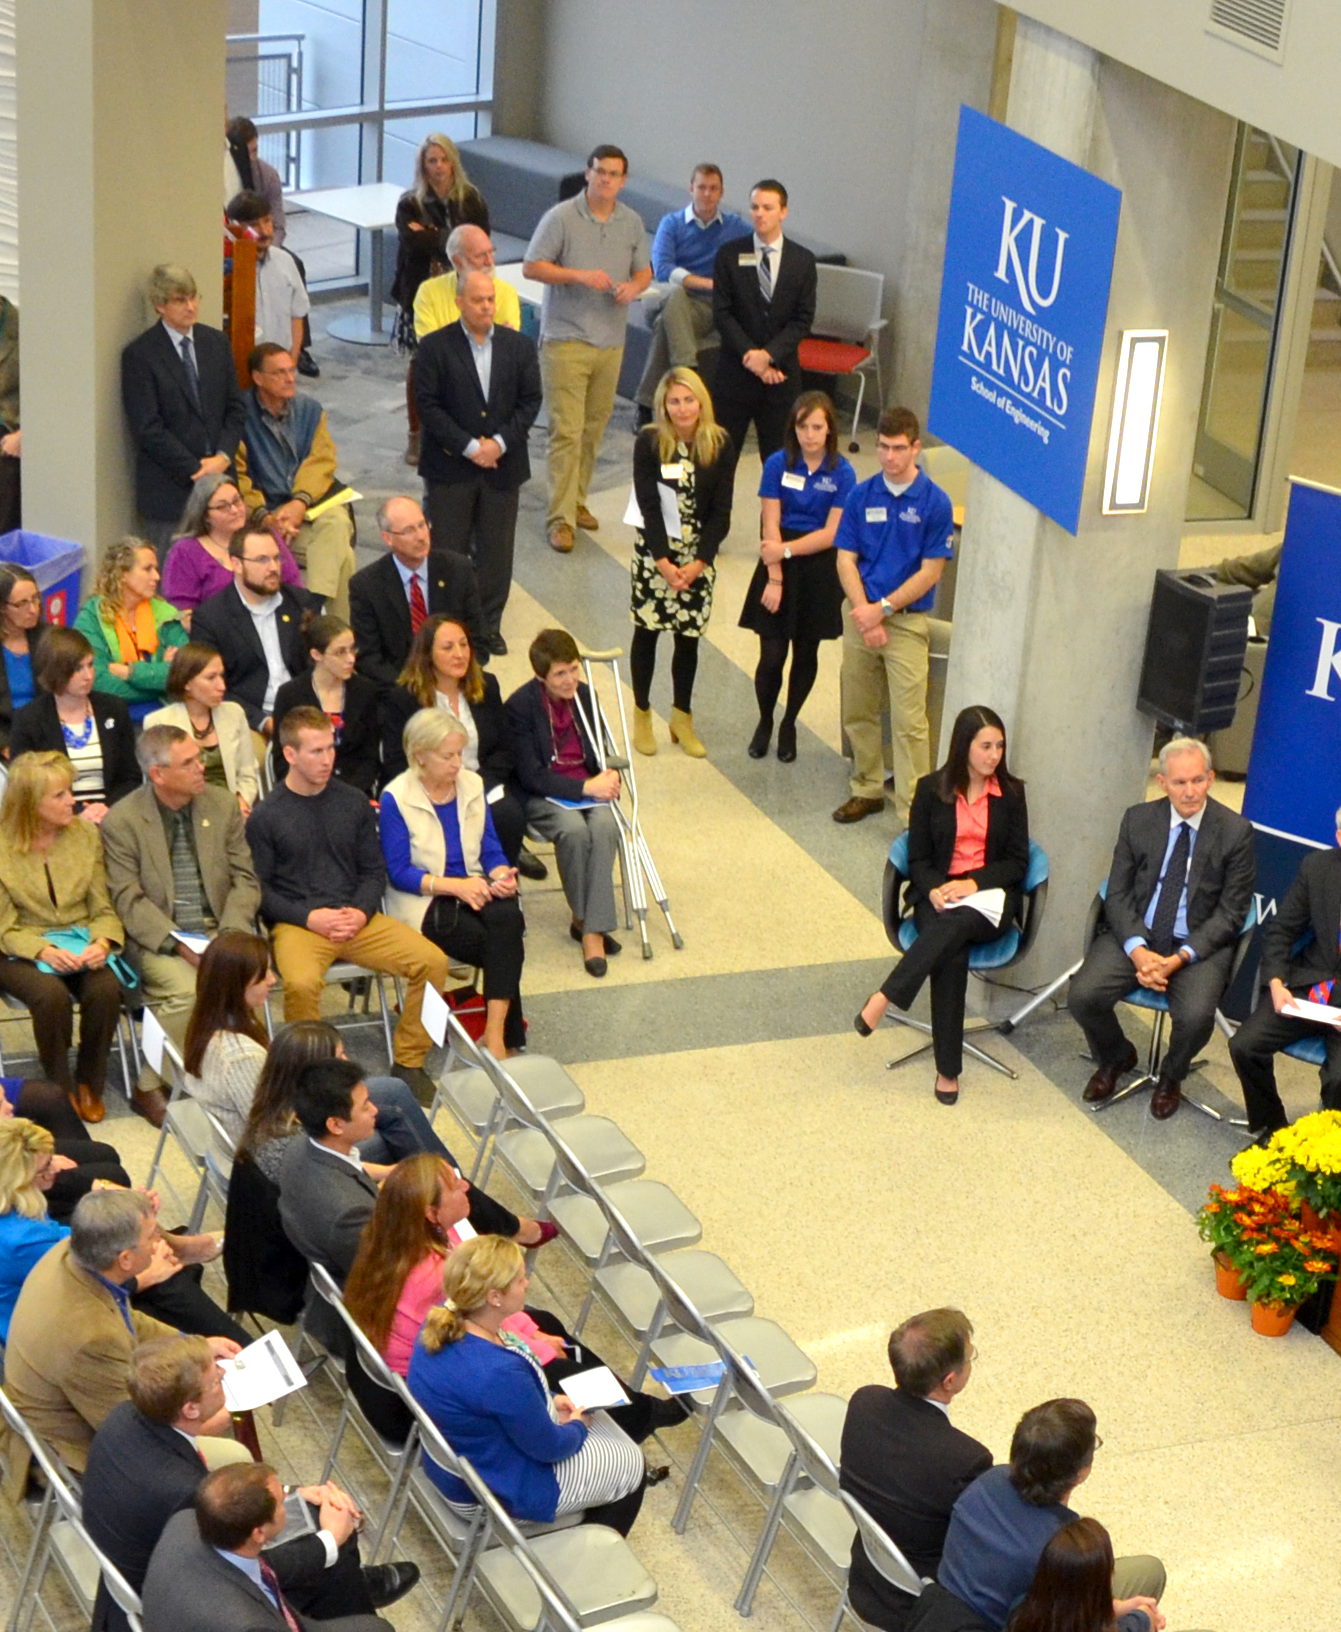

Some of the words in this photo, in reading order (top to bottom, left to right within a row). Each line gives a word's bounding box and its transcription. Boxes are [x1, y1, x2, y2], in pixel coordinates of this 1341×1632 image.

[993, 195, 1070, 315] KU
[961, 305, 1071, 416] KANSAS
[967, 282, 990, 313] THE
[991, 297, 1057, 354] UNIVERSITY
[1057, 340, 1074, 366] OF
[970, 376, 996, 406] School
[996, 396, 1006, 411] of
[1004, 399, 1050, 444] Engineering
